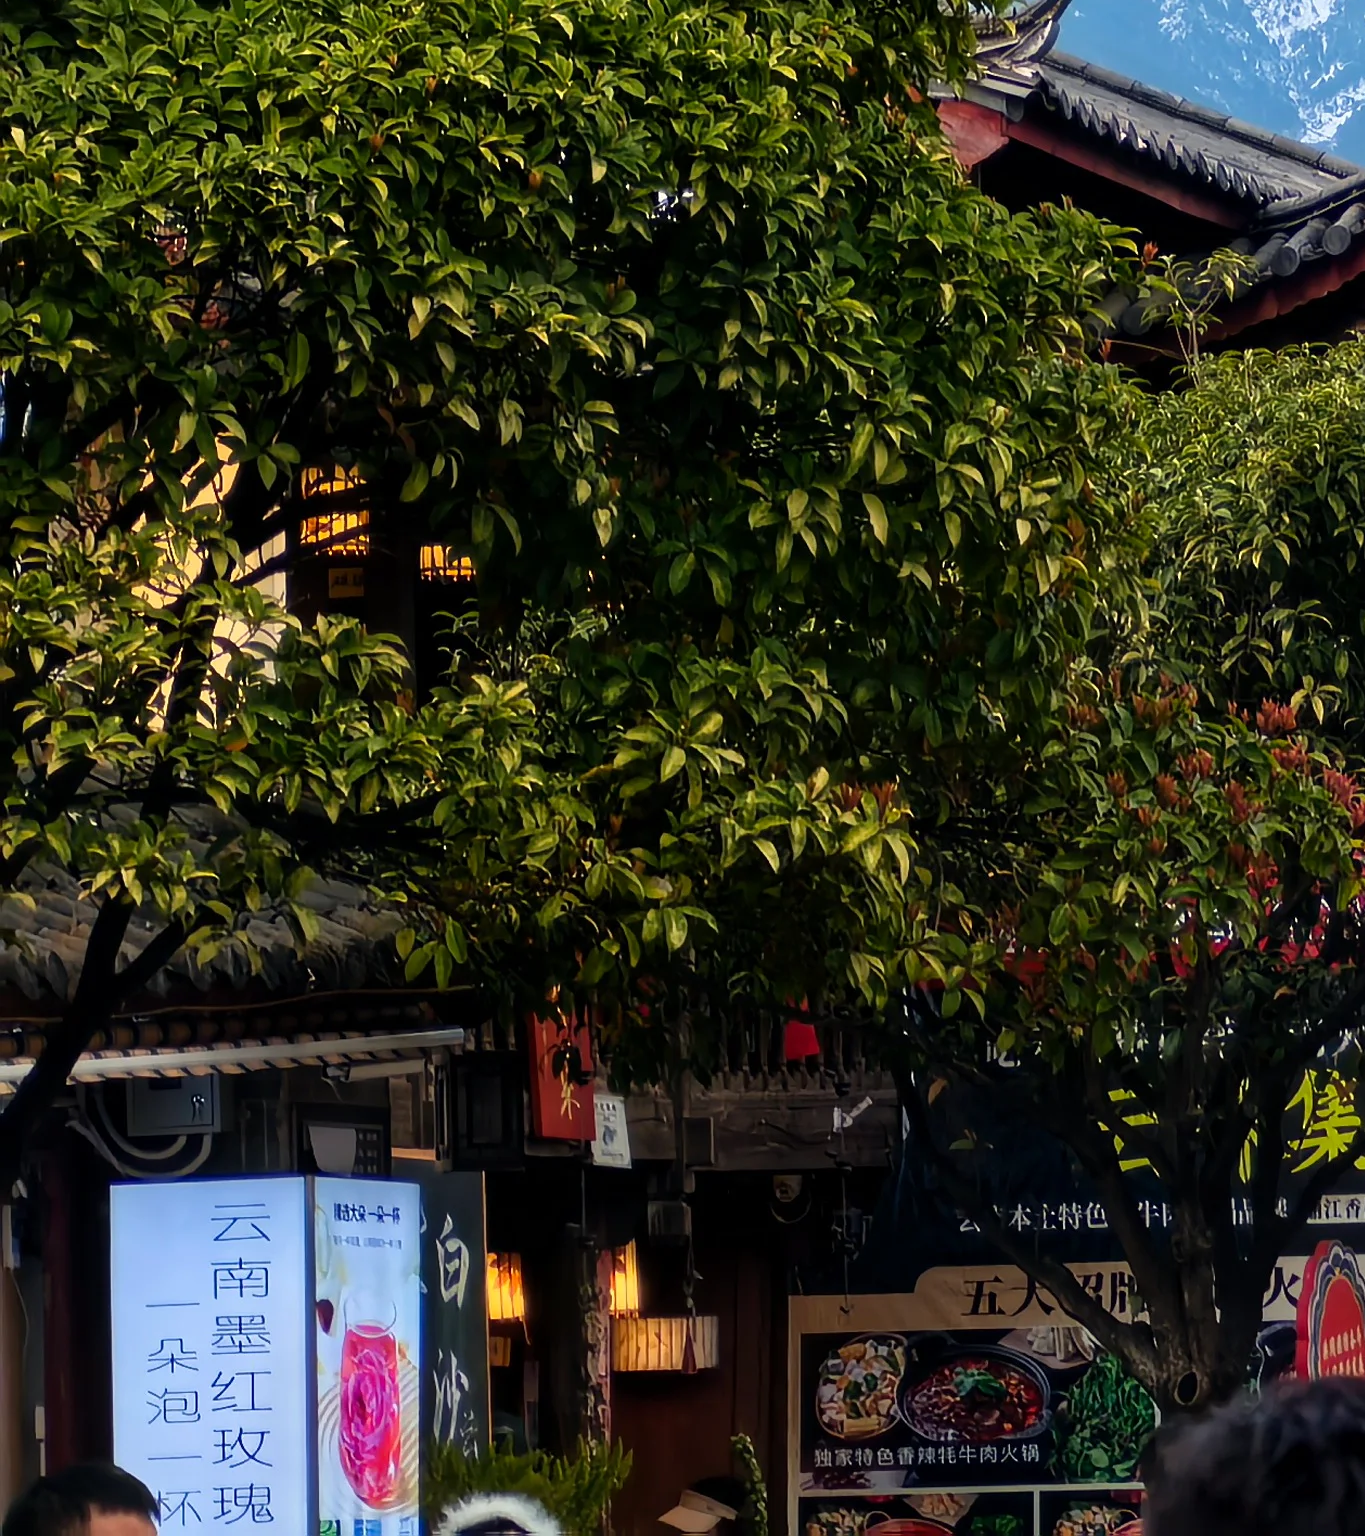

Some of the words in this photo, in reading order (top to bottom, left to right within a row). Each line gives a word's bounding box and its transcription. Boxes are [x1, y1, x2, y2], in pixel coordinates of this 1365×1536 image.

[146, 1303, 202, 1527] 一朵泡一杯
[210, 1203, 274, 1525] 云南墨红玫瑰
[813, 1443, 1040, 1468] 独家特色香辣牦牛肉火锅
